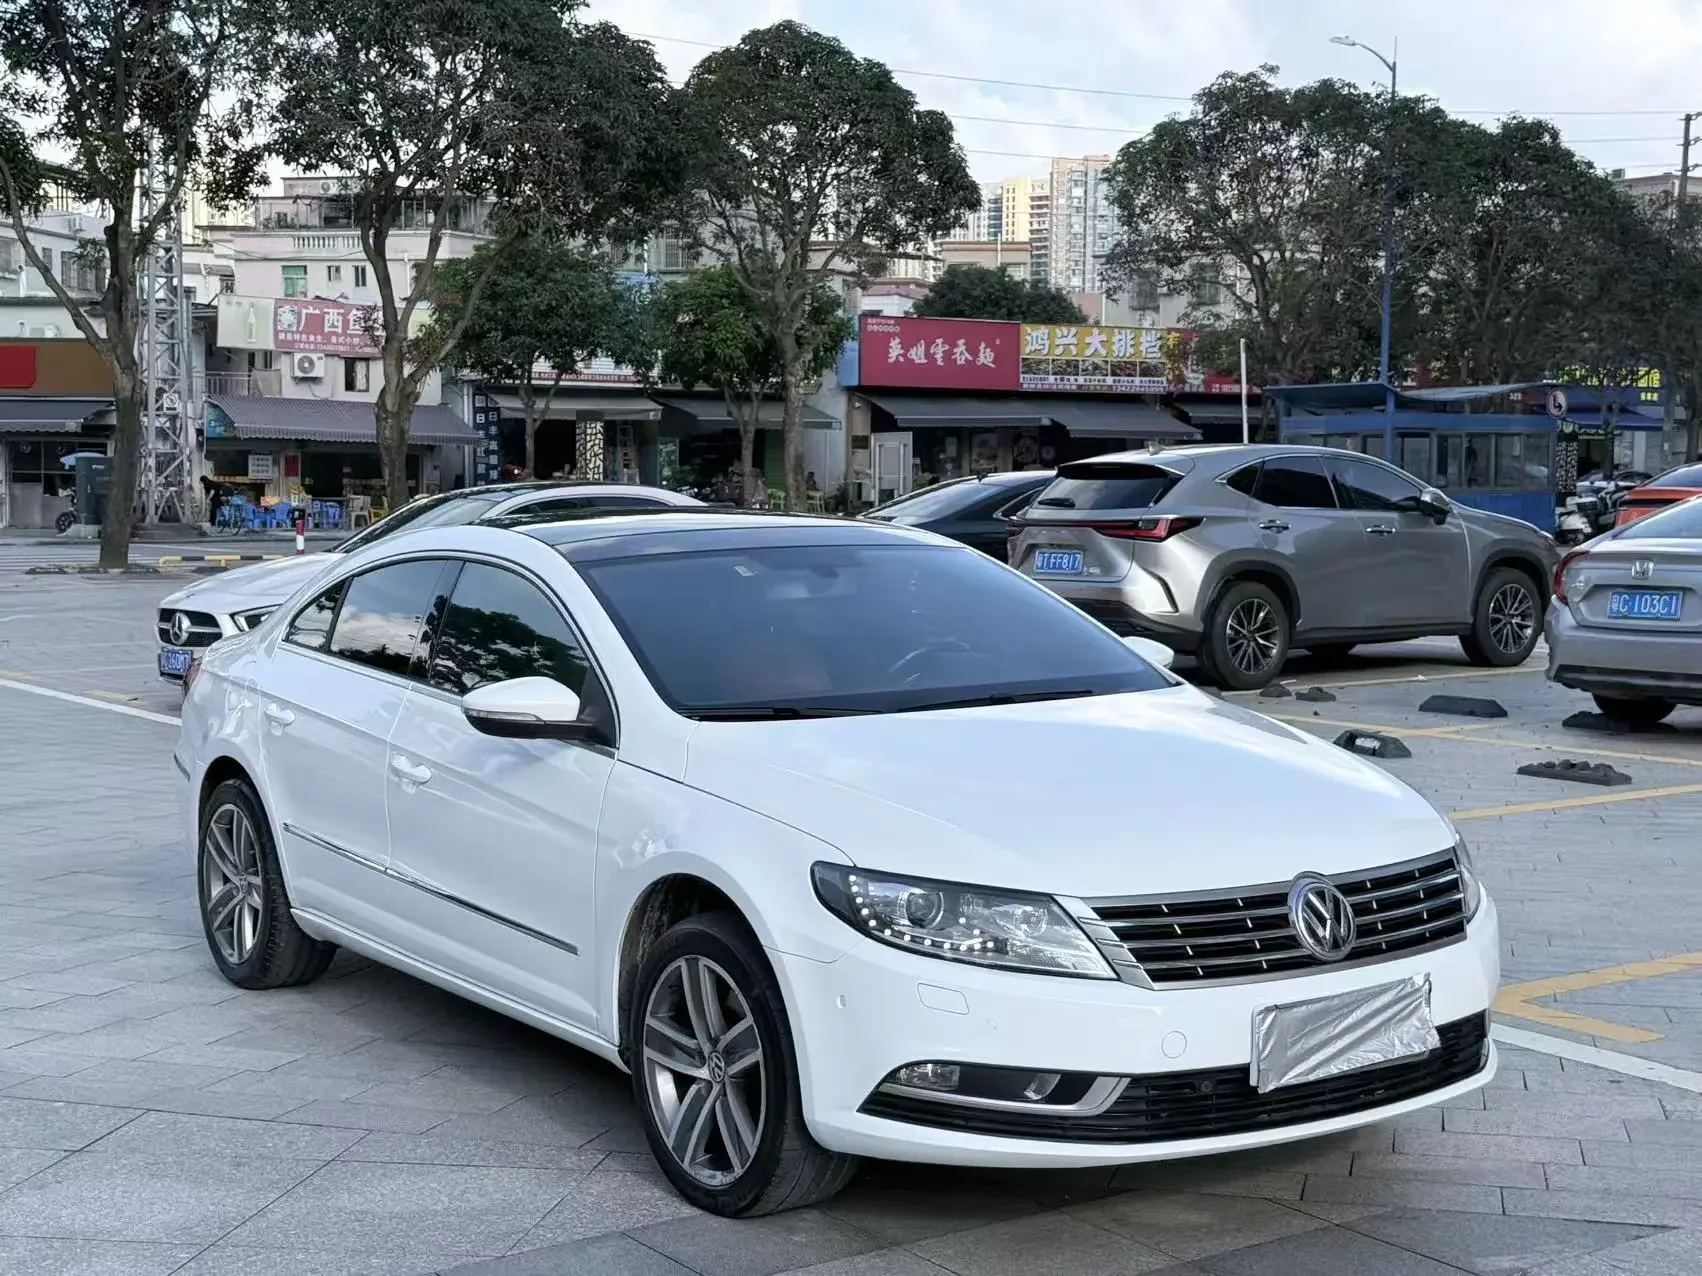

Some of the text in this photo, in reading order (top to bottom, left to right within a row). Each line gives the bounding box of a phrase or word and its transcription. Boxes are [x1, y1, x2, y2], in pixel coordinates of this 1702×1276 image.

[1024, 326, 1162, 359] 鸿兴大排档
